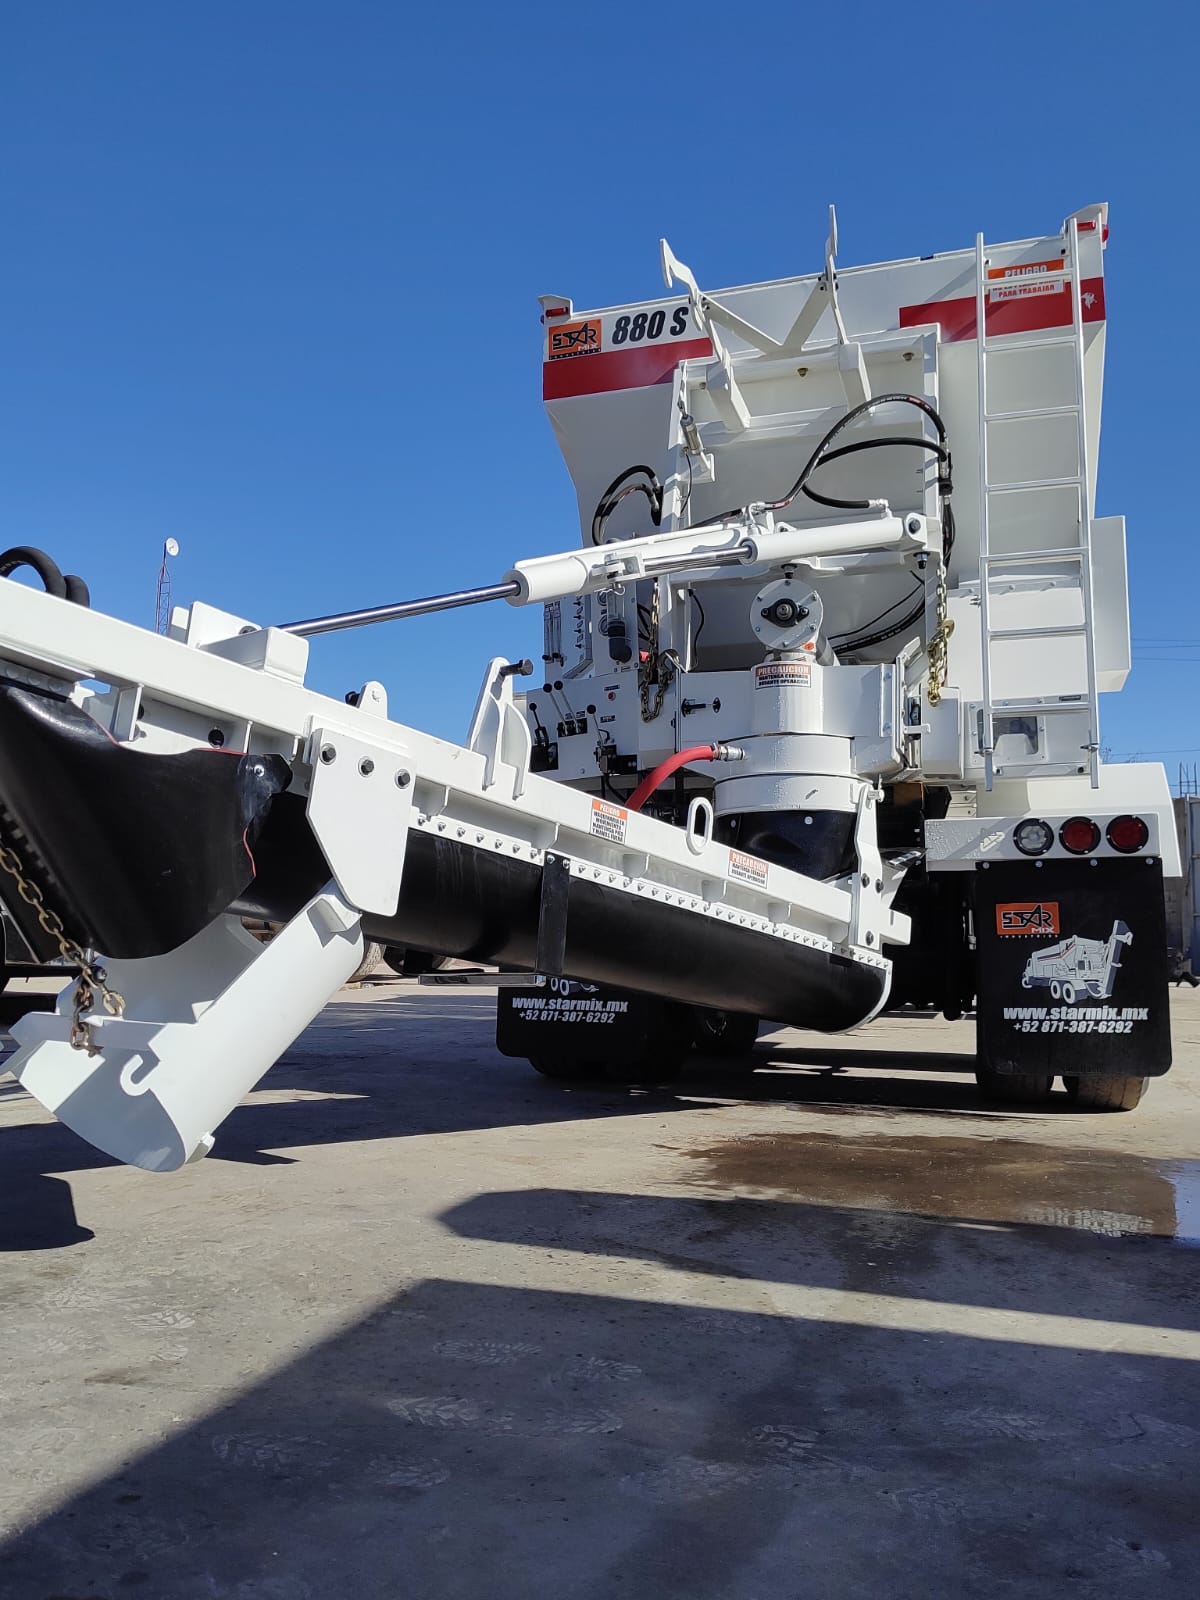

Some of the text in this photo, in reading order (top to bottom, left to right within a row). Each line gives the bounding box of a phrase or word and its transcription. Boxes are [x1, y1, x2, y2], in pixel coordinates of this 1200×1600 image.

[998, 289, 1018, 298] PARA
[1019, 284, 1055, 296] TRABAJAR
[612, 306, 689, 345] 880 S
[552, 322, 597, 350] STAR
[1002, 904, 1054, 929] STAR
[512, 998, 628, 1012] www.starmix.mx
[520, 1010, 616, 1023] +52 871-387-6292
[1003, 1005, 1149, 1020] www.starmix.mx
[1013, 1021, 1134, 1033] +52 871-387-6292
